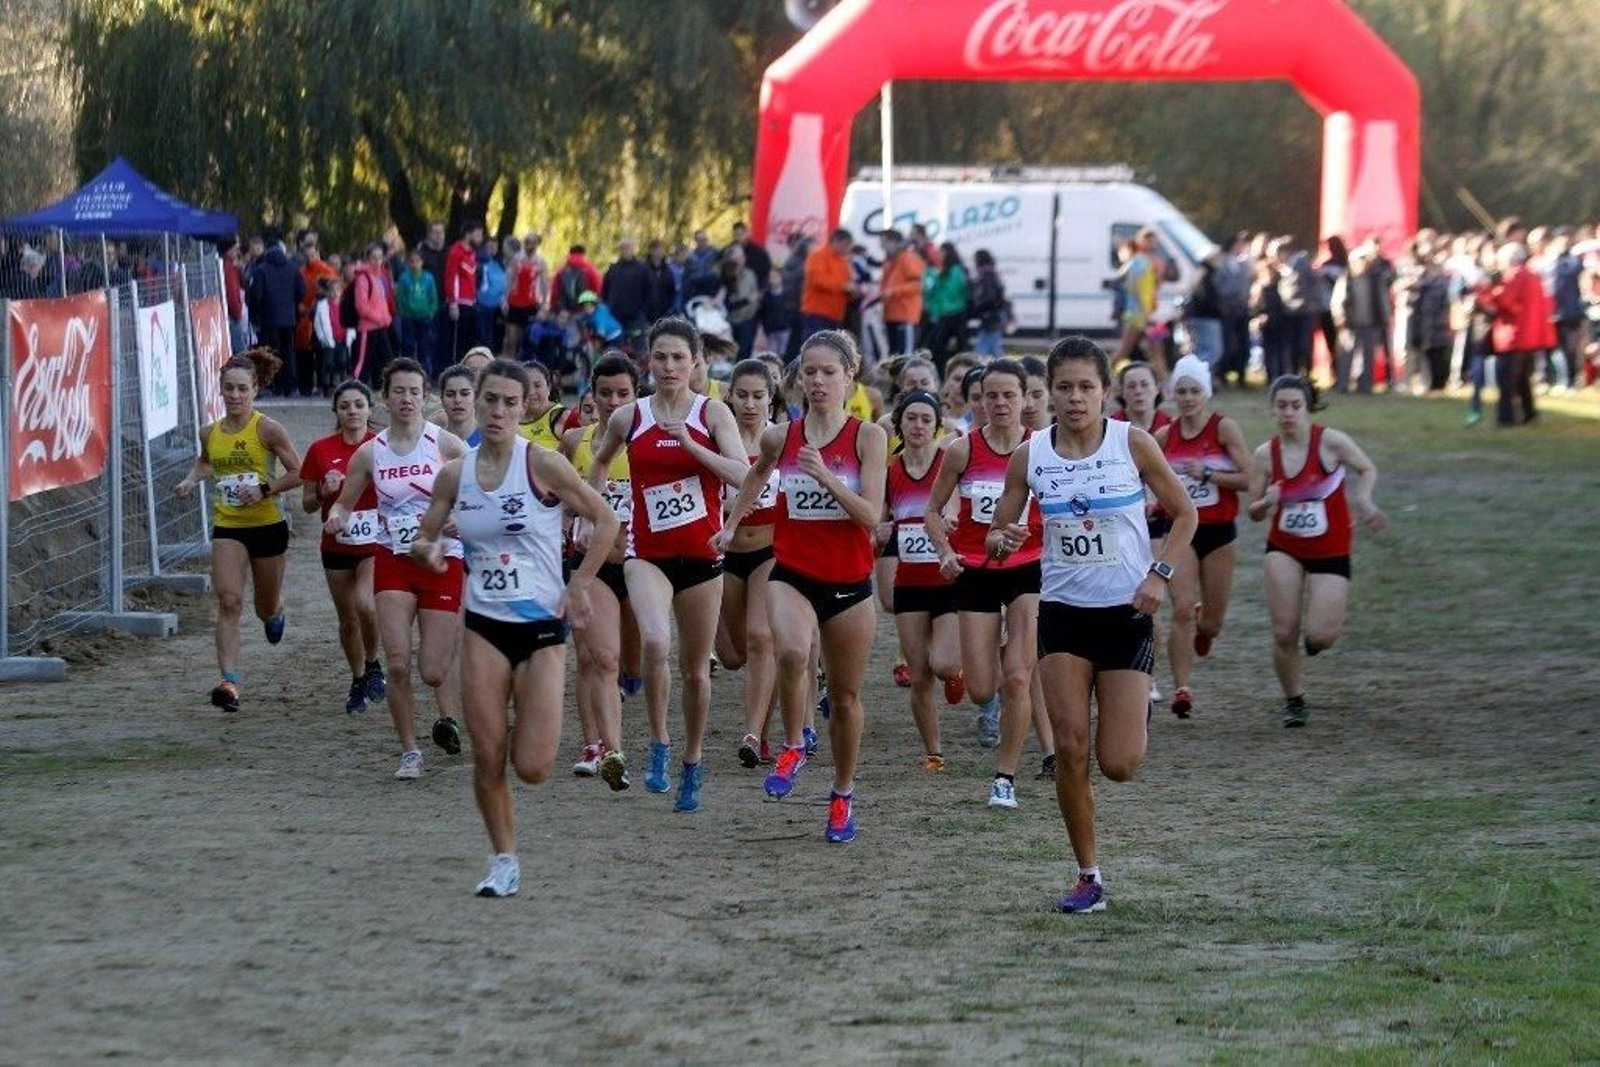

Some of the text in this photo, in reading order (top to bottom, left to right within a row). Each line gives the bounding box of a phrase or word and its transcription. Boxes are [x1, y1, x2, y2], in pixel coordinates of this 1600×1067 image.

[963, 0, 1228, 71] Coca-Cola
[379, 464, 433, 480] TREGA
[795, 490, 838, 510] 222
[1188, 483, 1211, 499] 25
[655, 493, 696, 521] 233
[349, 521, 371, 537] 46
[1286, 513, 1318, 529] 503
[1060, 533, 1104, 556] 501
[481, 567, 519, 590] 231
